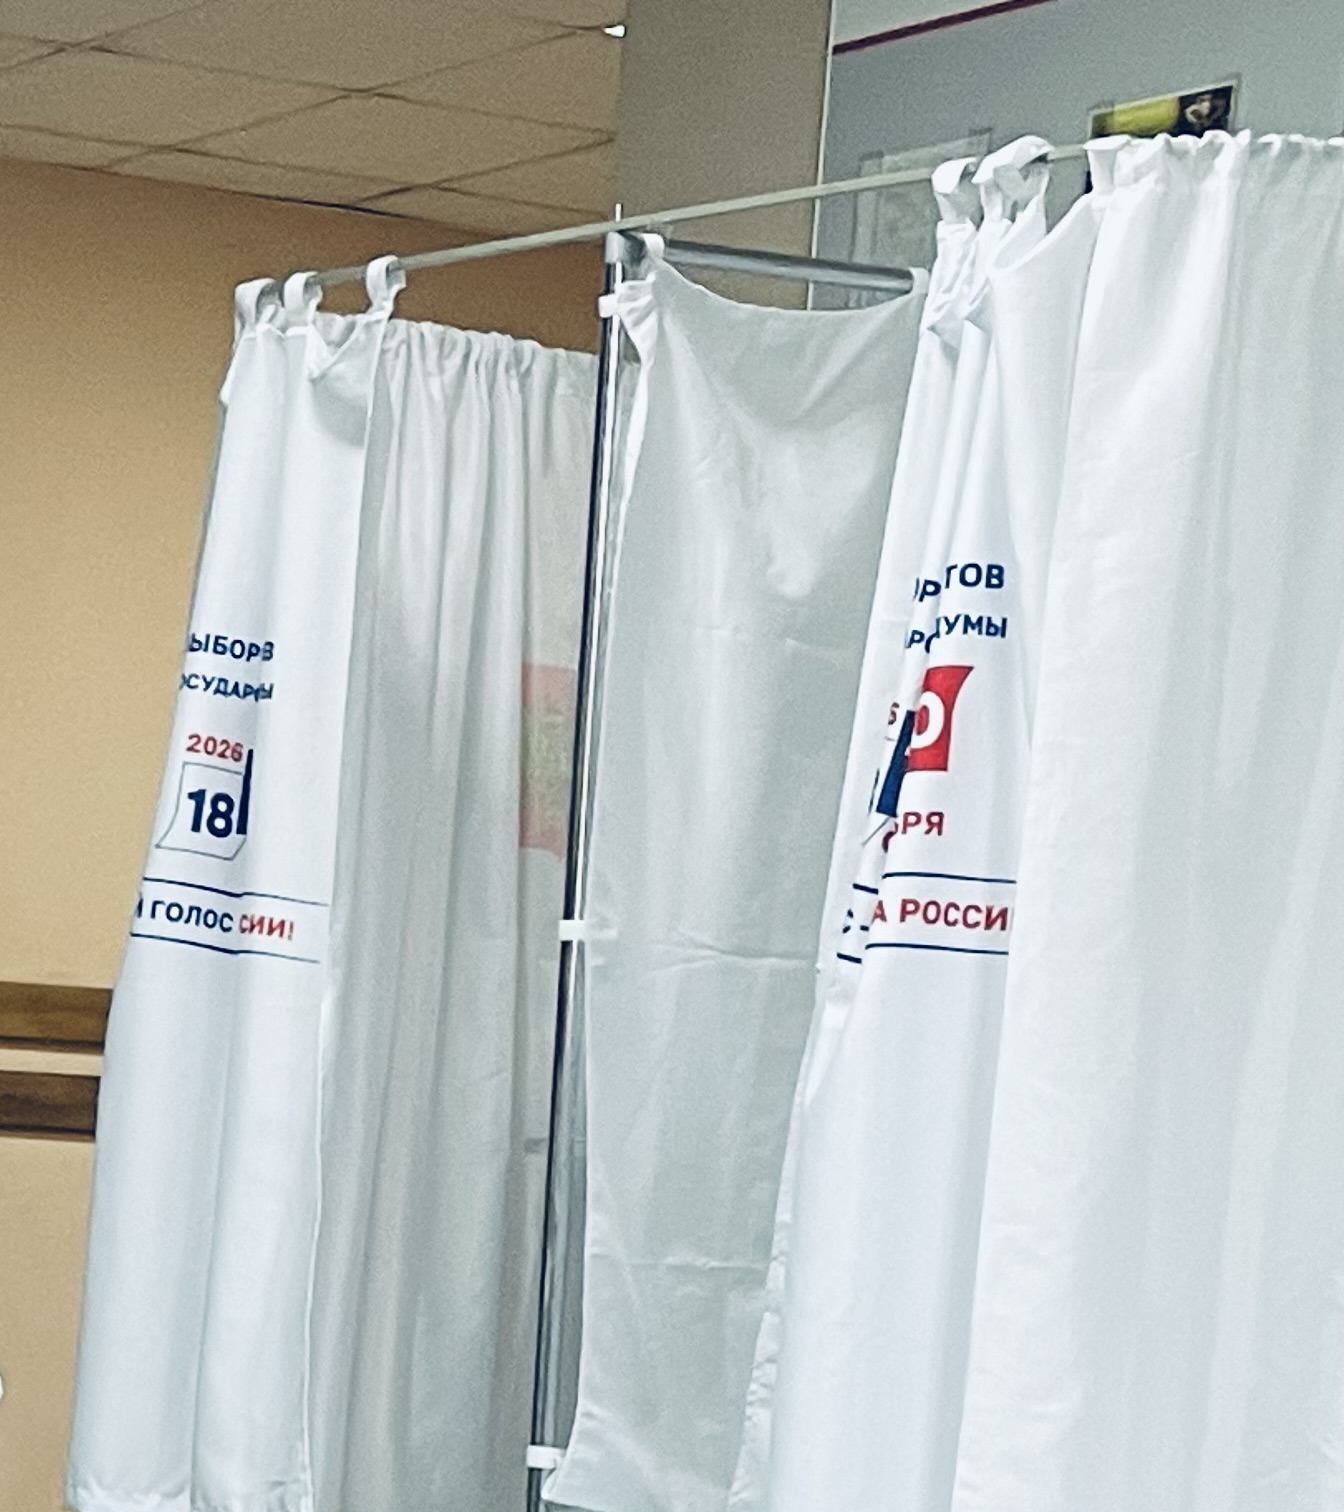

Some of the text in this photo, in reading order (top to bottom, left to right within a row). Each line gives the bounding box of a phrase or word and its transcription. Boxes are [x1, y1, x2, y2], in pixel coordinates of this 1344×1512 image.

[185, 734, 244, 762] 2026
[187, 789, 235, 838] 18
[150, 900, 234, 933] ГОЛОС
[899, 898, 1010, 932] РОССИ
